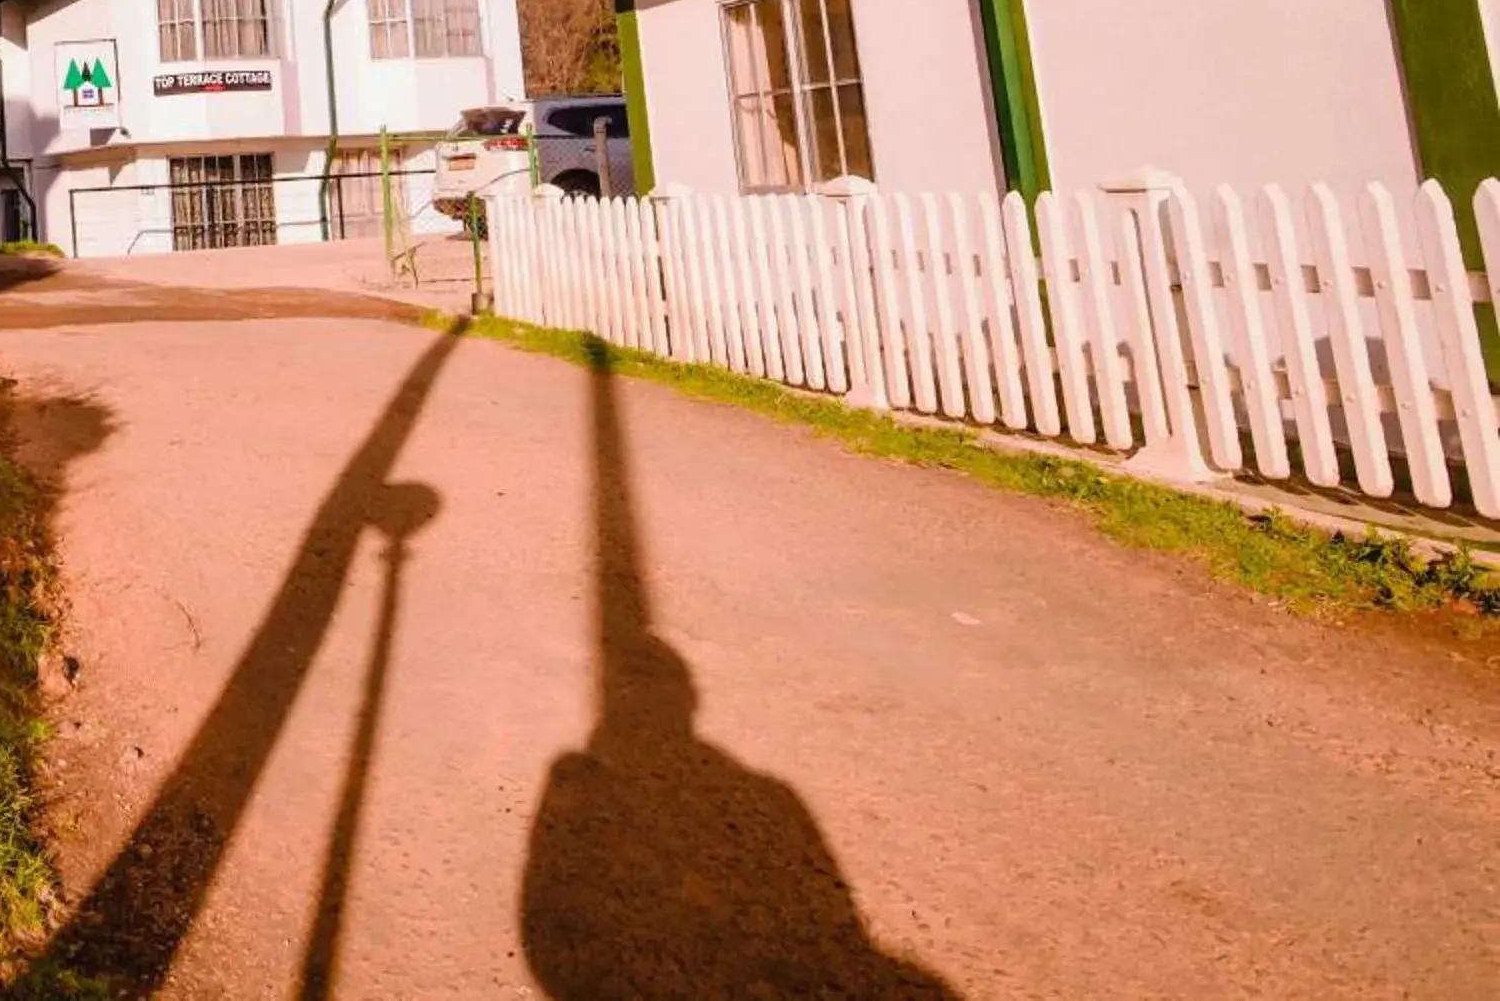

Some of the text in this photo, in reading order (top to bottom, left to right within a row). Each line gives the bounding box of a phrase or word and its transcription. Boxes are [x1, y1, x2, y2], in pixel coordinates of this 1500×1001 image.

[155, 72, 270, 88] TOP TERRACE COTTAGE
